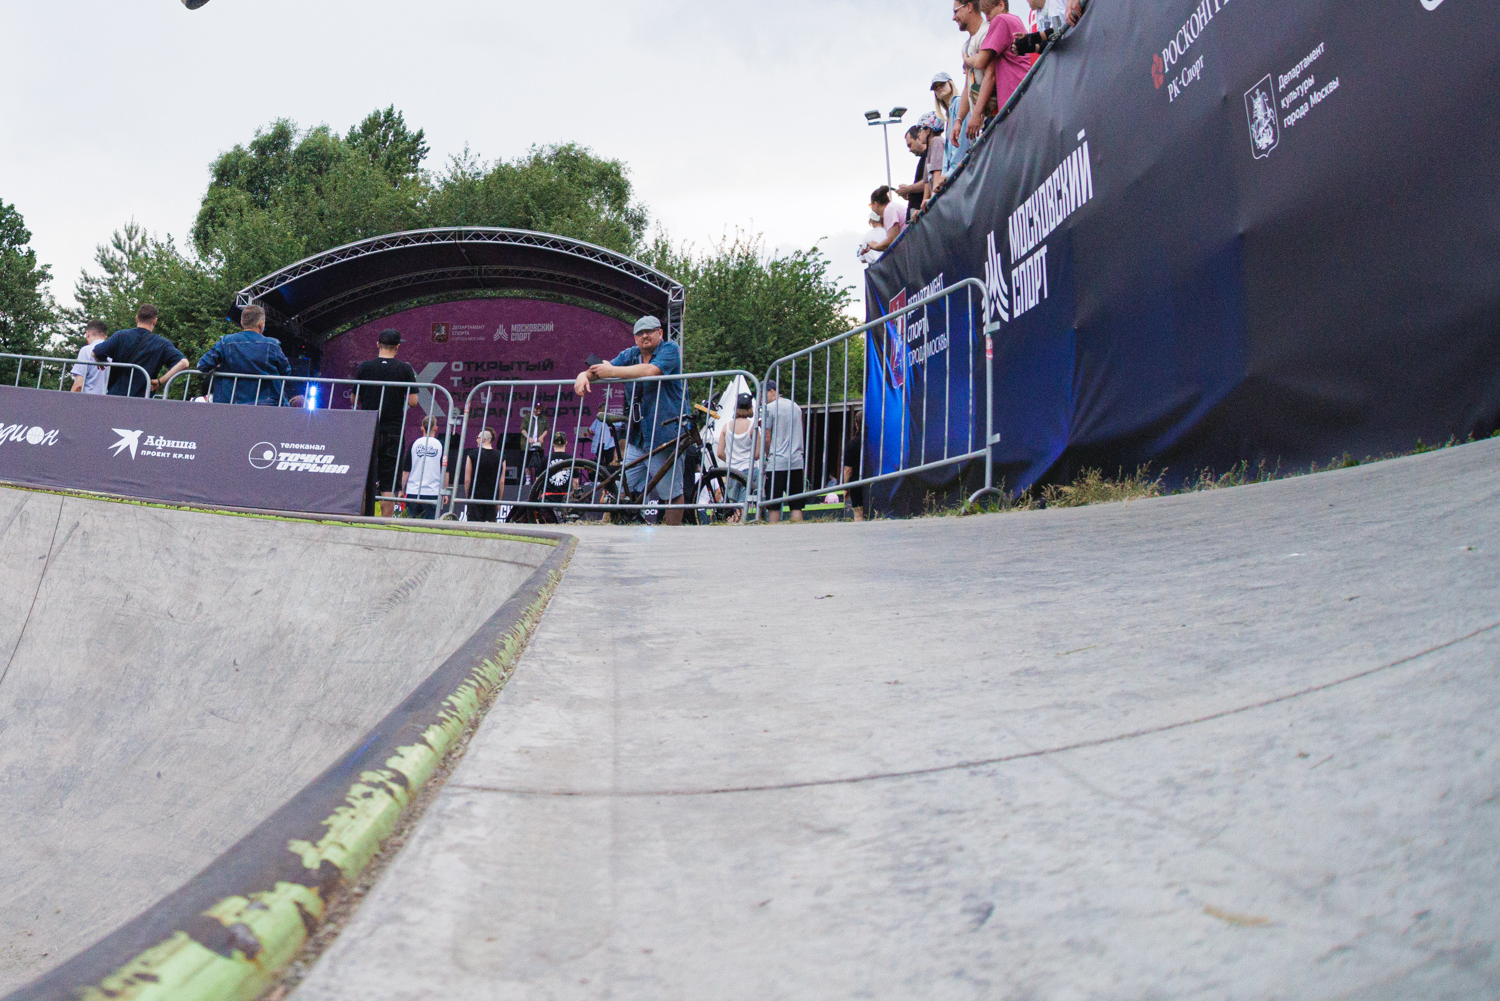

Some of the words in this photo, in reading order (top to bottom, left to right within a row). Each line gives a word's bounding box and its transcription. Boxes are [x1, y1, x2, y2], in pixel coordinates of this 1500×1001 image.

[1278, 42, 1325, 92] Департамент
[1167, 55, 1204, 103] РК-Спорт
[1280, 74, 1315, 108] культуры
[1283, 102, 1309, 128] города
[1309, 77, 1340, 107] Москвы
[1008, 128, 1093, 264] МОСКОВСКИЙ
[1011, 244, 1048, 319] СПОРТ
[511, 321, 554, 332] МОСКОВСКИЙ
[511, 332, 531, 341] СПОРТ
[451, 358, 554, 371] ОТКРЫТЫЙ
[143, 435, 197, 450] Афиша
[280, 442, 326, 451] телеканал
[140, 450, 171, 458] ПРОЕКТ
[278, 452, 335, 464] ТОЧКА
[276, 461, 350, 474] ОТРЫВА
